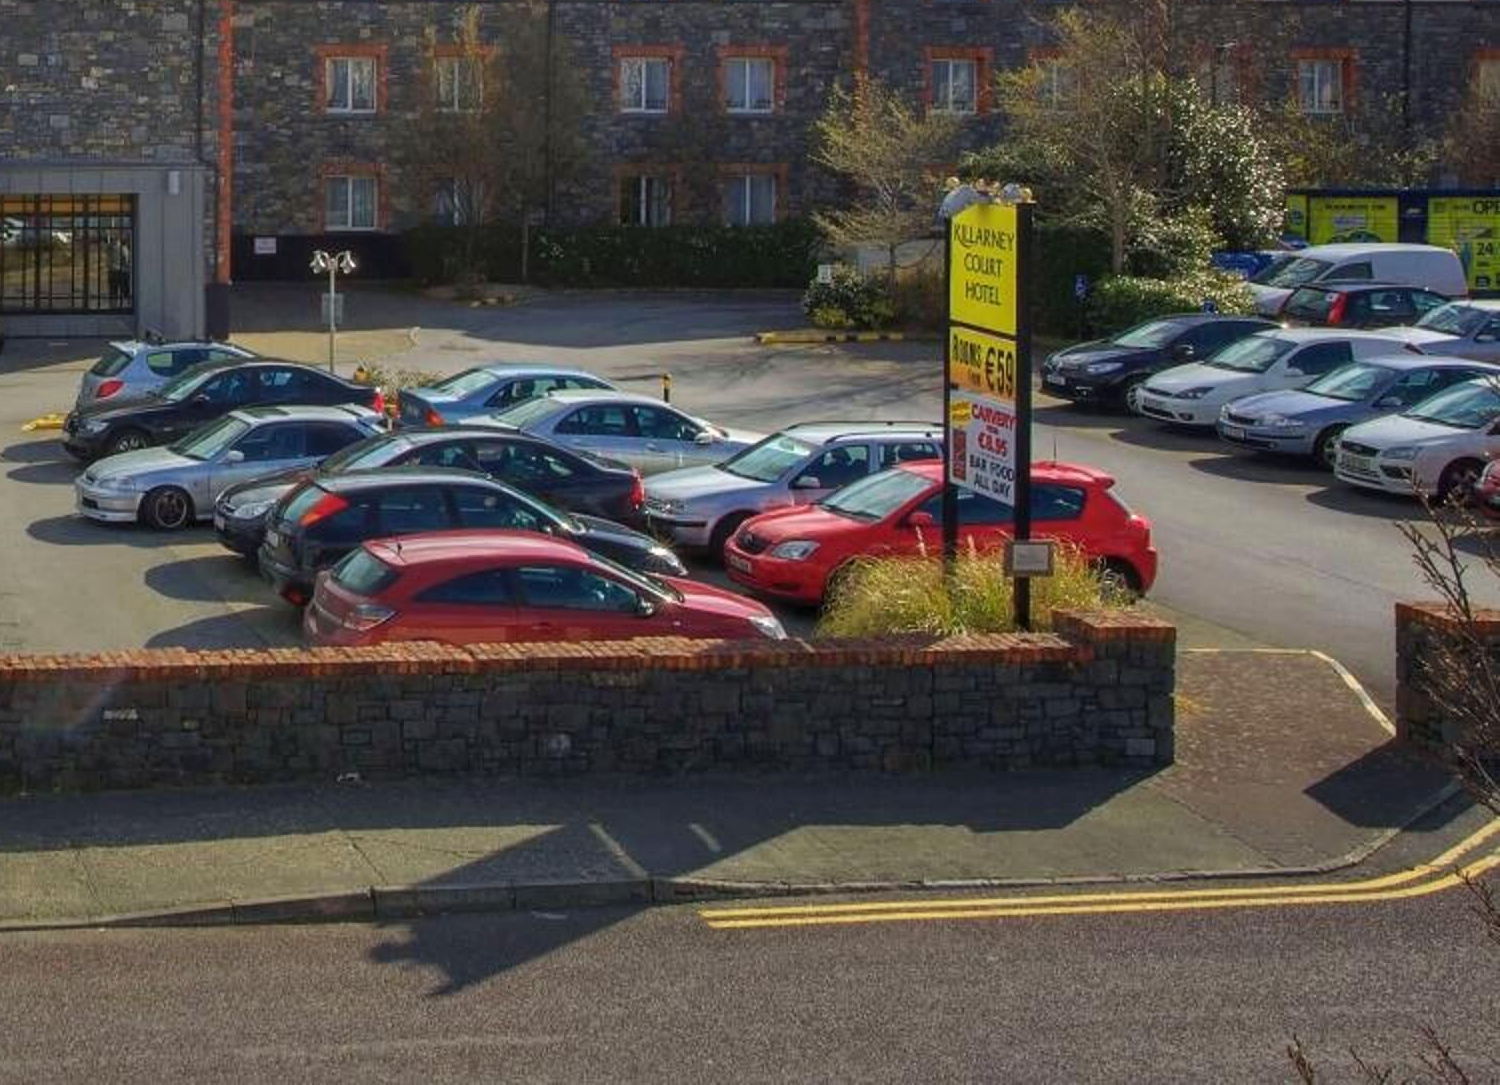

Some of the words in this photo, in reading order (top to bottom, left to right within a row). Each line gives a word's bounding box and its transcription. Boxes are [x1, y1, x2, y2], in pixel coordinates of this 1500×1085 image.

[953, 224, 1015, 252] KILLARNEY
[1477, 242, 1493, 256] 24
[964, 253, 1004, 277] COURT
[965, 281, 1002, 306] HOTEL
[953, 334, 982, 369] ROOMS
[985, 346, 1014, 396] €59
[971, 403, 1016, 431] CARVERY
[970, 454, 987, 471] BAR
[990, 461, 1015, 482] FOOD
[974, 472, 990, 491] ALL
[992, 480, 1011, 498] DAY
